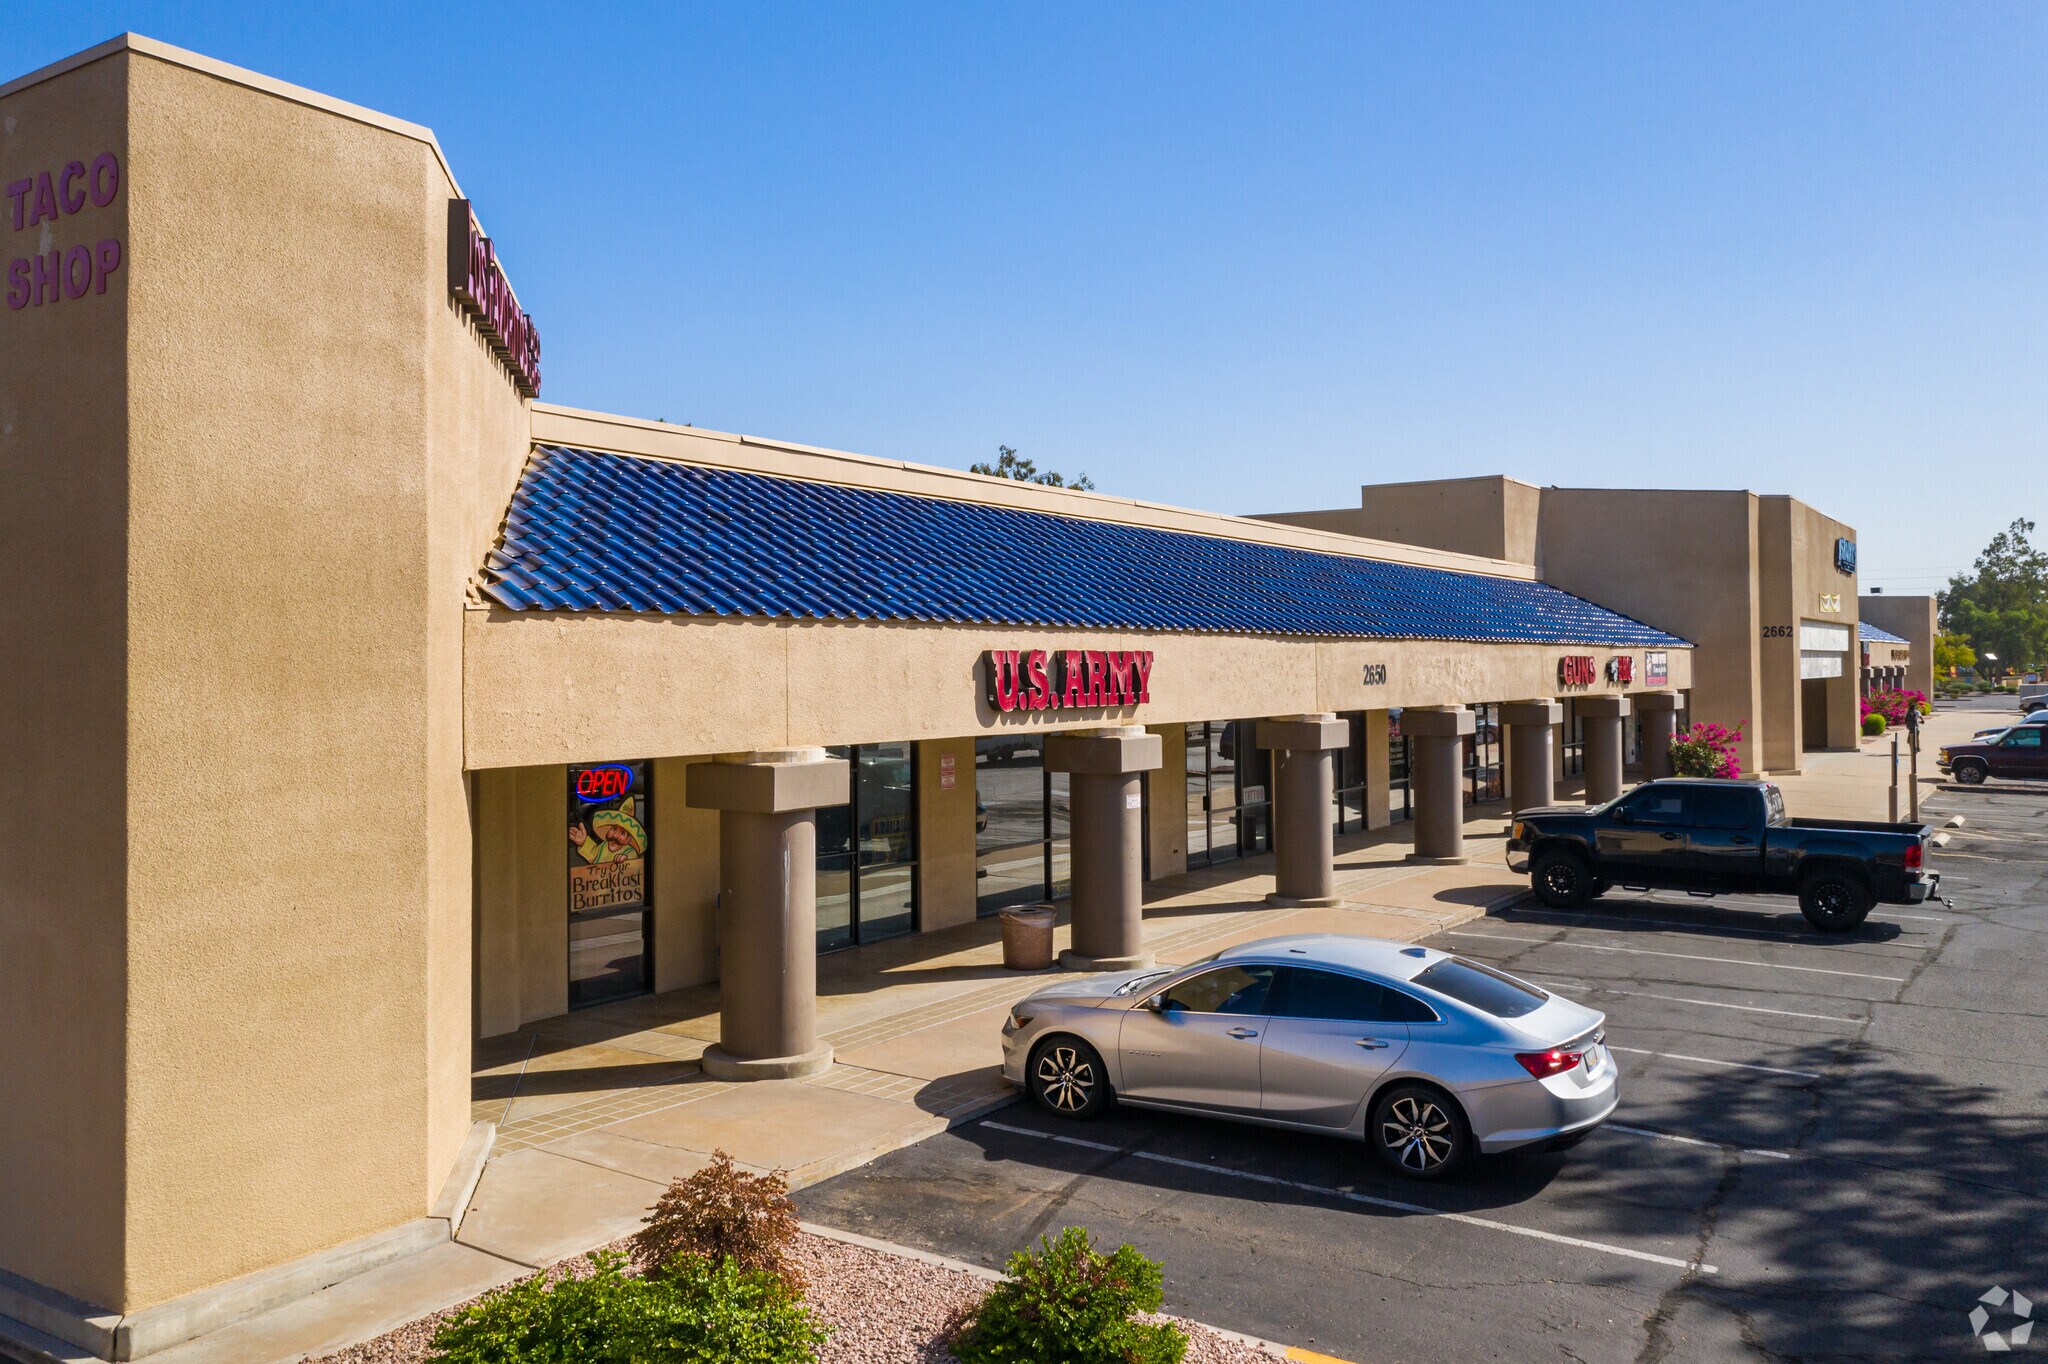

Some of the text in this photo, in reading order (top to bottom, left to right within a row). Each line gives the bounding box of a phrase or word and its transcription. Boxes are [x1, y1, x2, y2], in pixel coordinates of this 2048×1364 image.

[7, 151, 119, 231] TACO
[7, 239, 121, 310] SHOP
[1763, 625, 1793, 638] 2662
[991, 649, 1153, 712] U.S. ARMY
[1362, 663, 1387, 686] 2650
[1563, 655, 1596, 685] GUNS
[577, 769, 628, 795] OPEN
[587, 861, 630, 878] Try Our
[572, 871, 641, 893] Breakfast
[573, 888, 642, 910] Burritos
